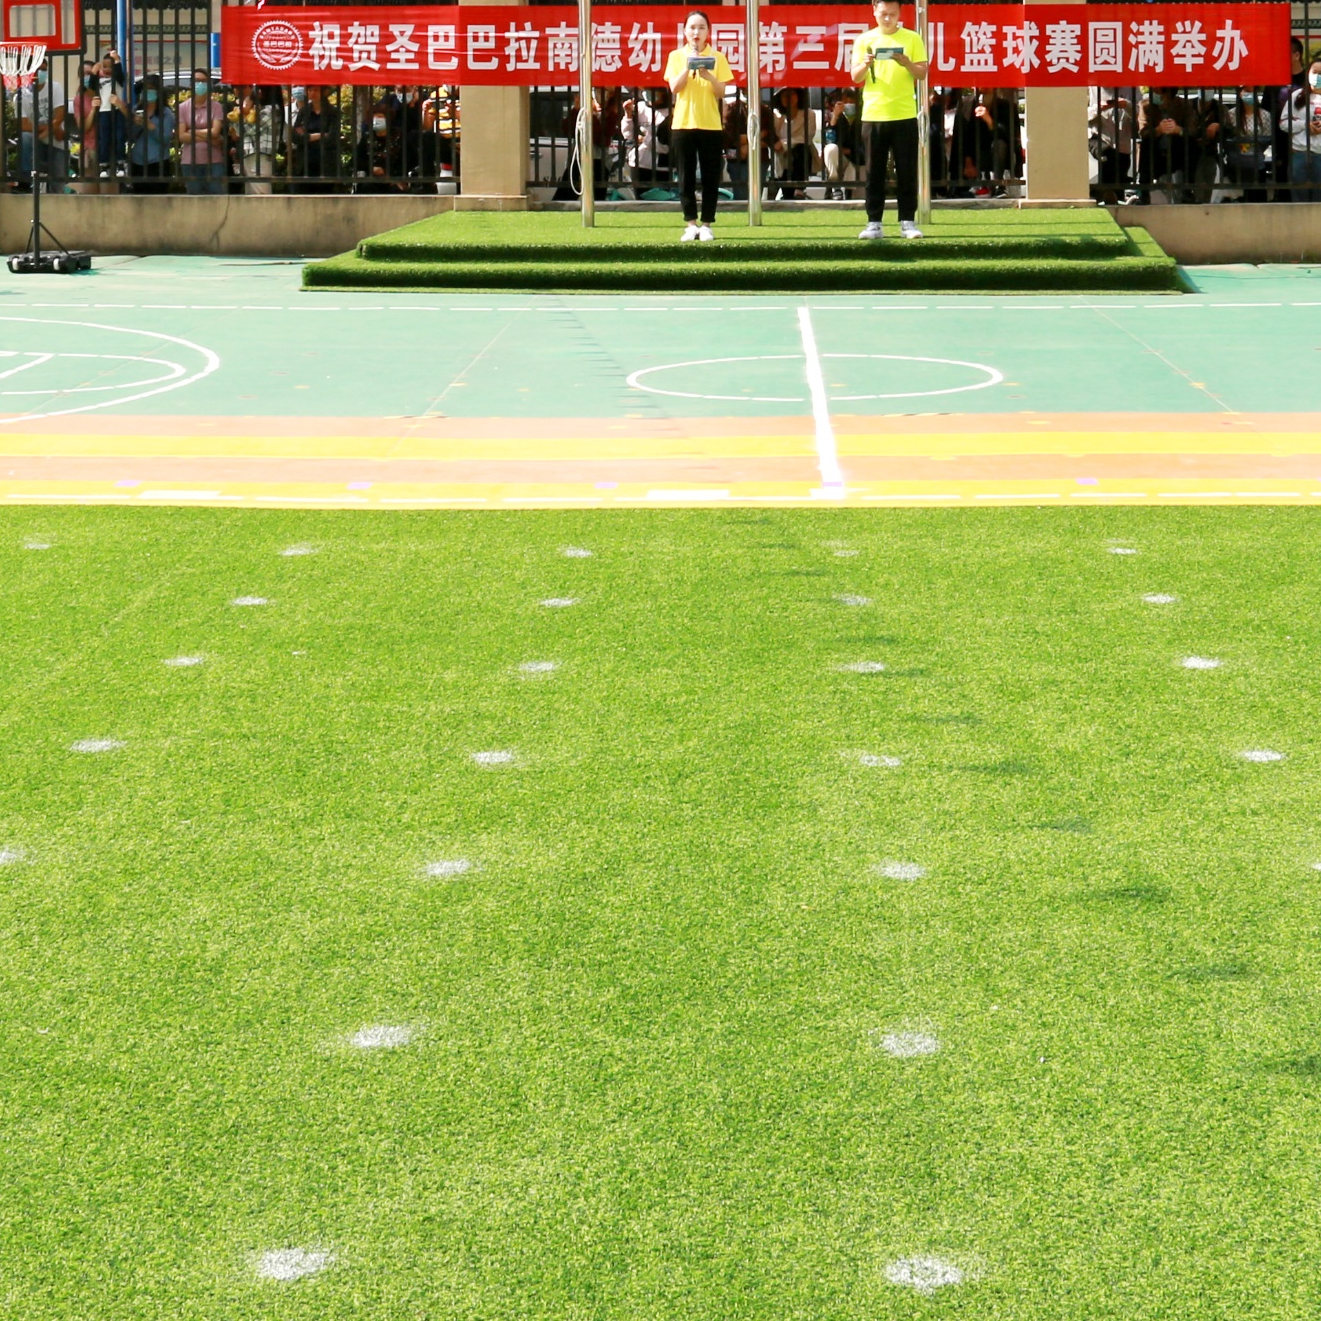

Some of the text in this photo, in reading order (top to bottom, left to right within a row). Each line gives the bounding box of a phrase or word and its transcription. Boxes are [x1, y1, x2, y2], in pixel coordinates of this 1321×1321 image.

[308, 19, 1249, 73] 祝贺圣巴巴拉南德幼园第三届儿篮球赛圆满举办
